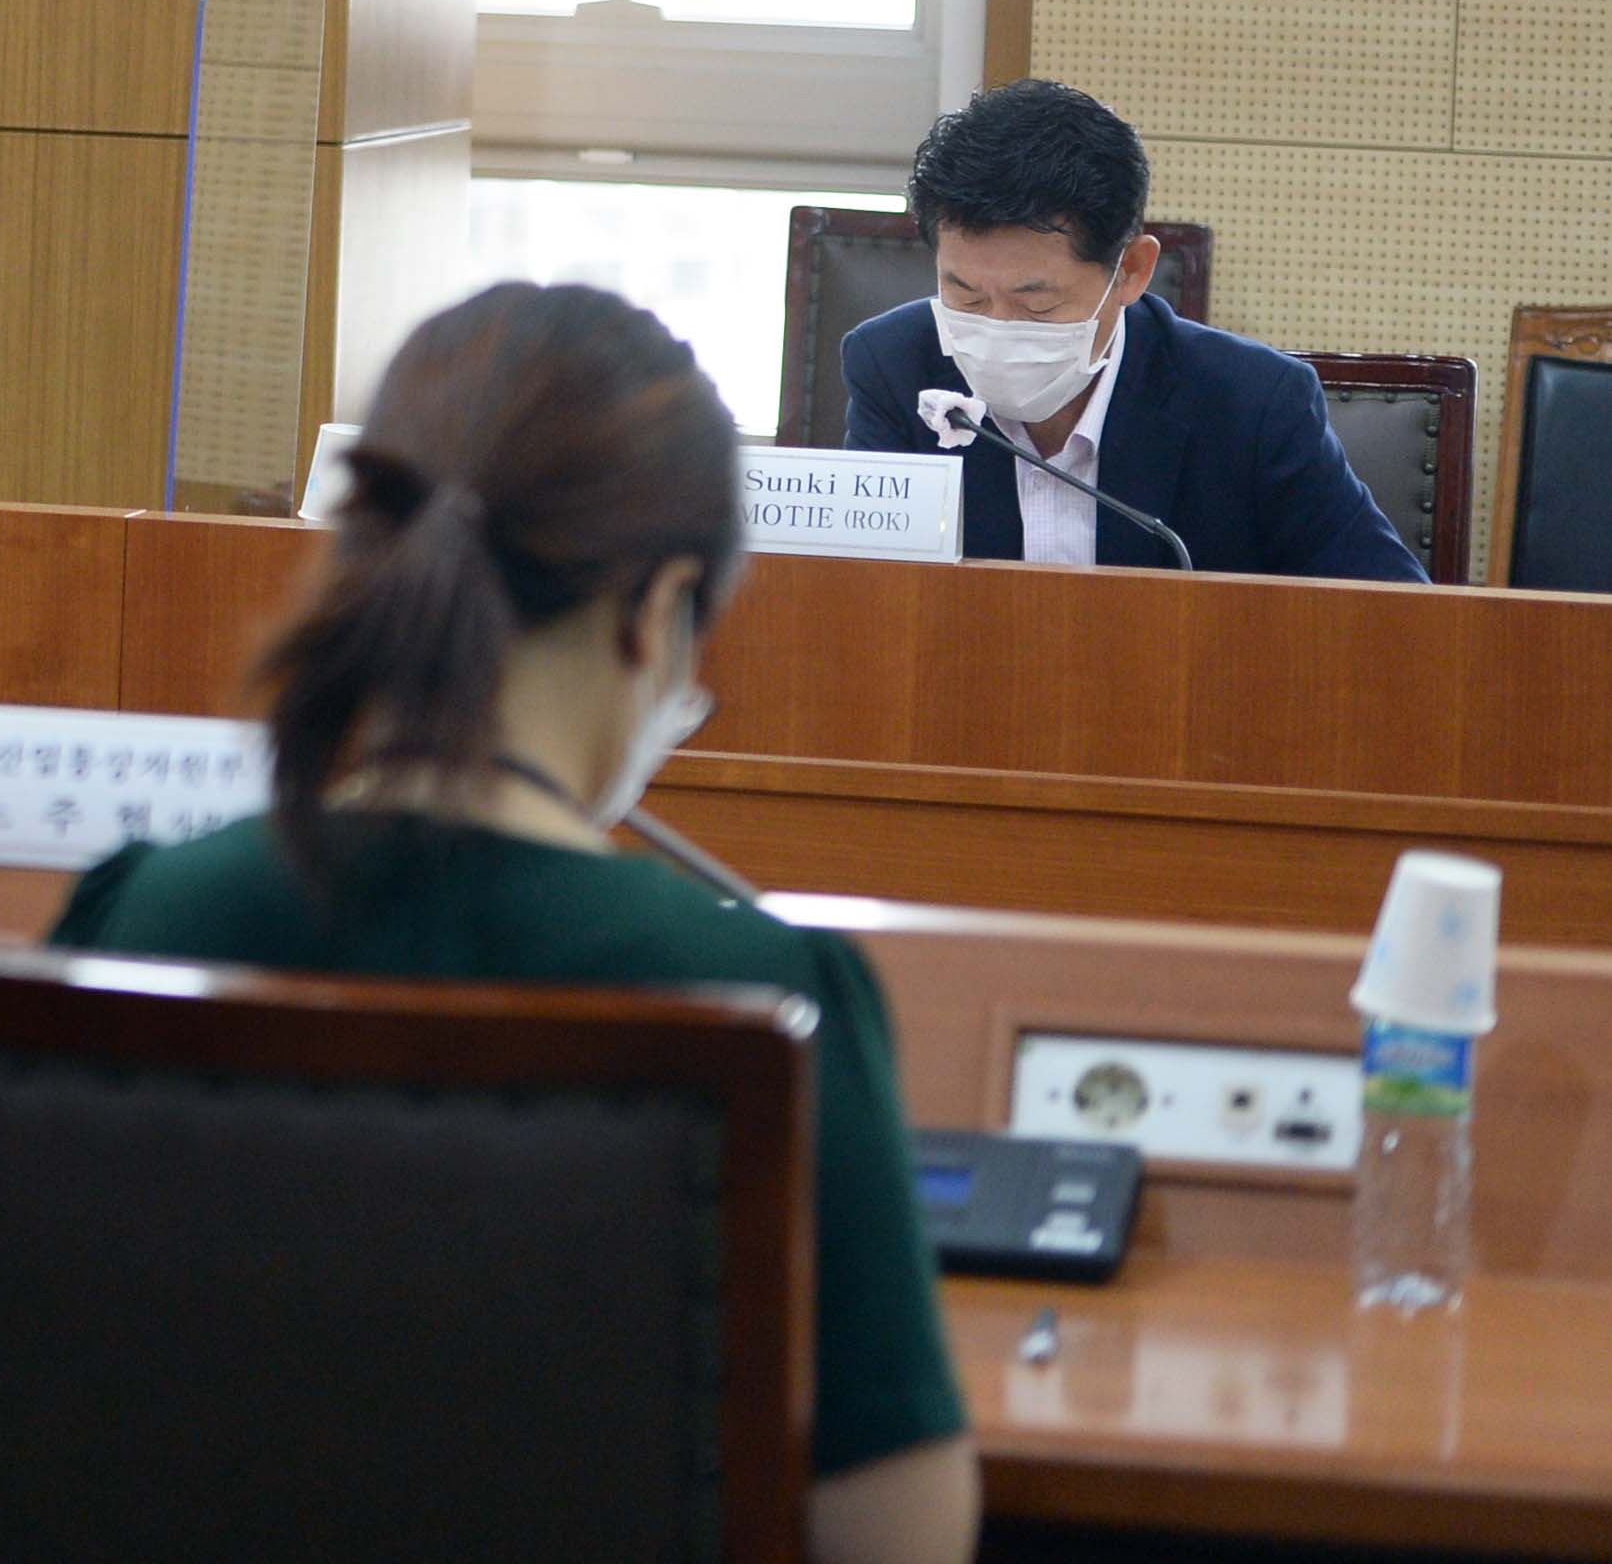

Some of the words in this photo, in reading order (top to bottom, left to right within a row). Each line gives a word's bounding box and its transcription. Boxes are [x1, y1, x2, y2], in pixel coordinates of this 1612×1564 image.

[744, 469, 836, 496] Sunki
[852, 474, 911, 500] KIM
[844, 509, 911, 532] (ROK)
